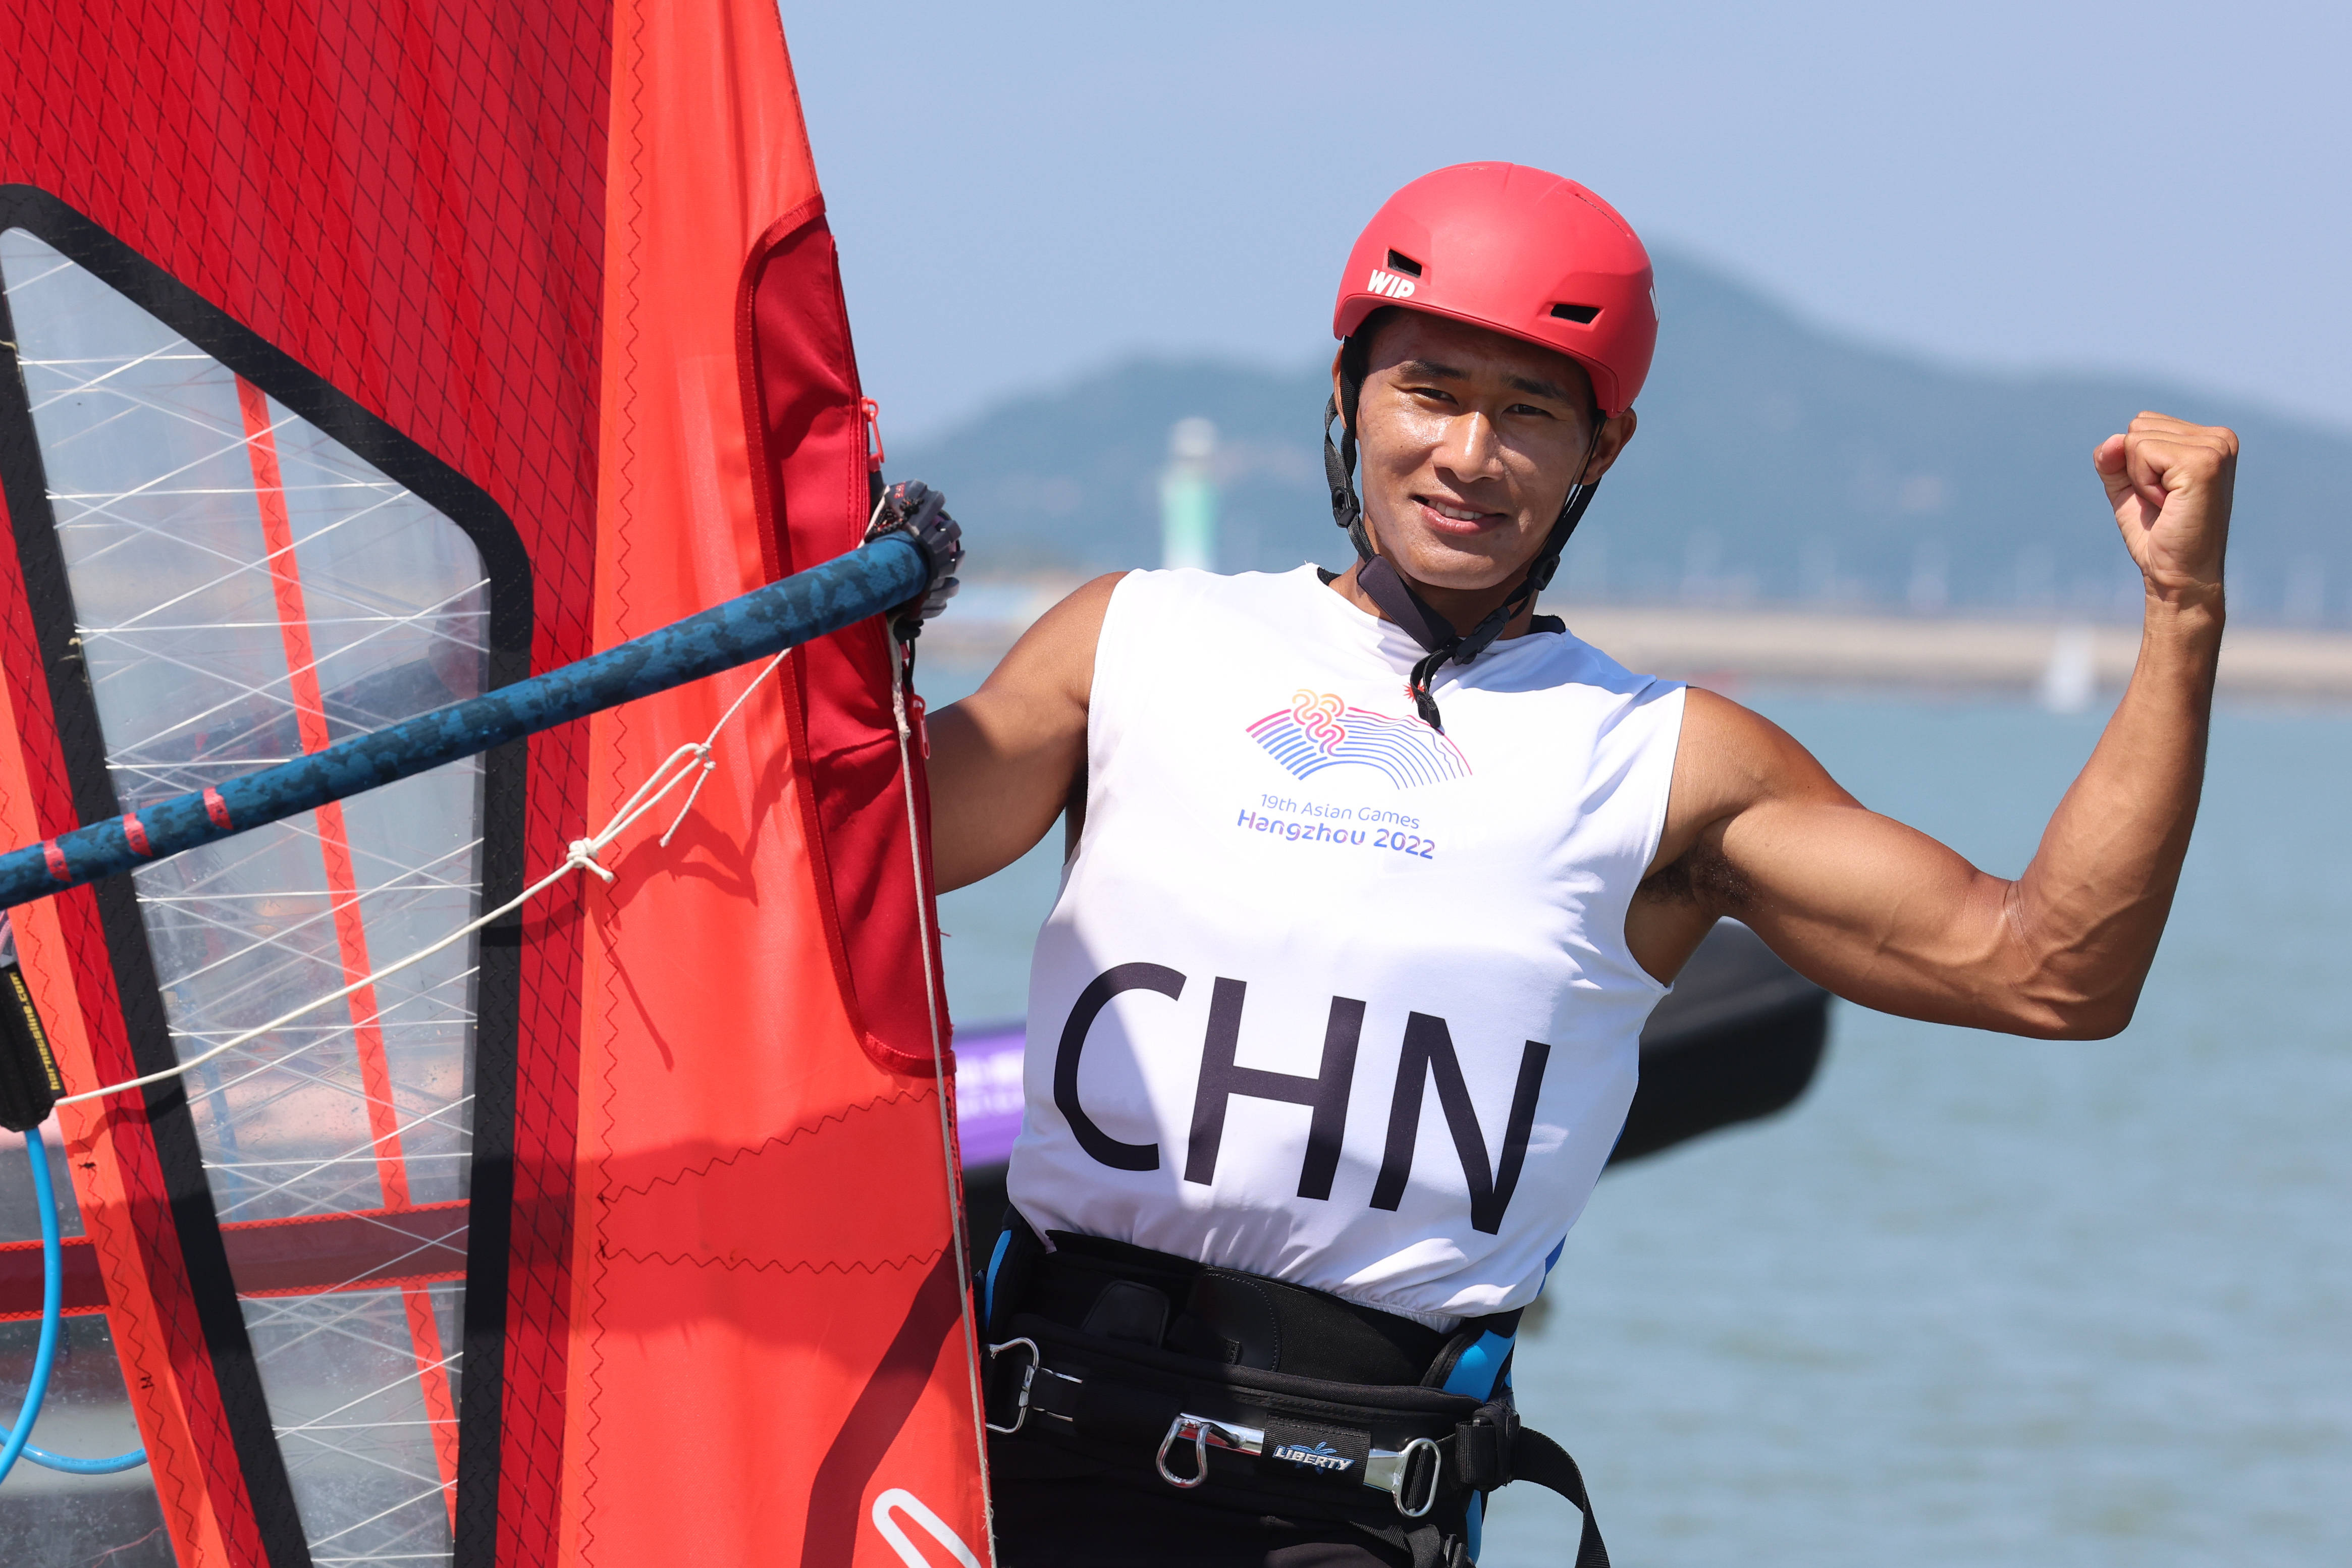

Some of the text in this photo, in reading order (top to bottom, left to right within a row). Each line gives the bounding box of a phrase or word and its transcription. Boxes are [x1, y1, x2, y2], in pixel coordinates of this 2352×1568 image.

[1367, 269, 1415, 298] WIP
[1261, 794, 1420, 829] 19th Asian Games
[1237, 809, 1435, 859] Hangzhou 2022
[1053, 962, 1551, 1235] CHN
[1274, 1447, 1353, 1471] LIBERTY
